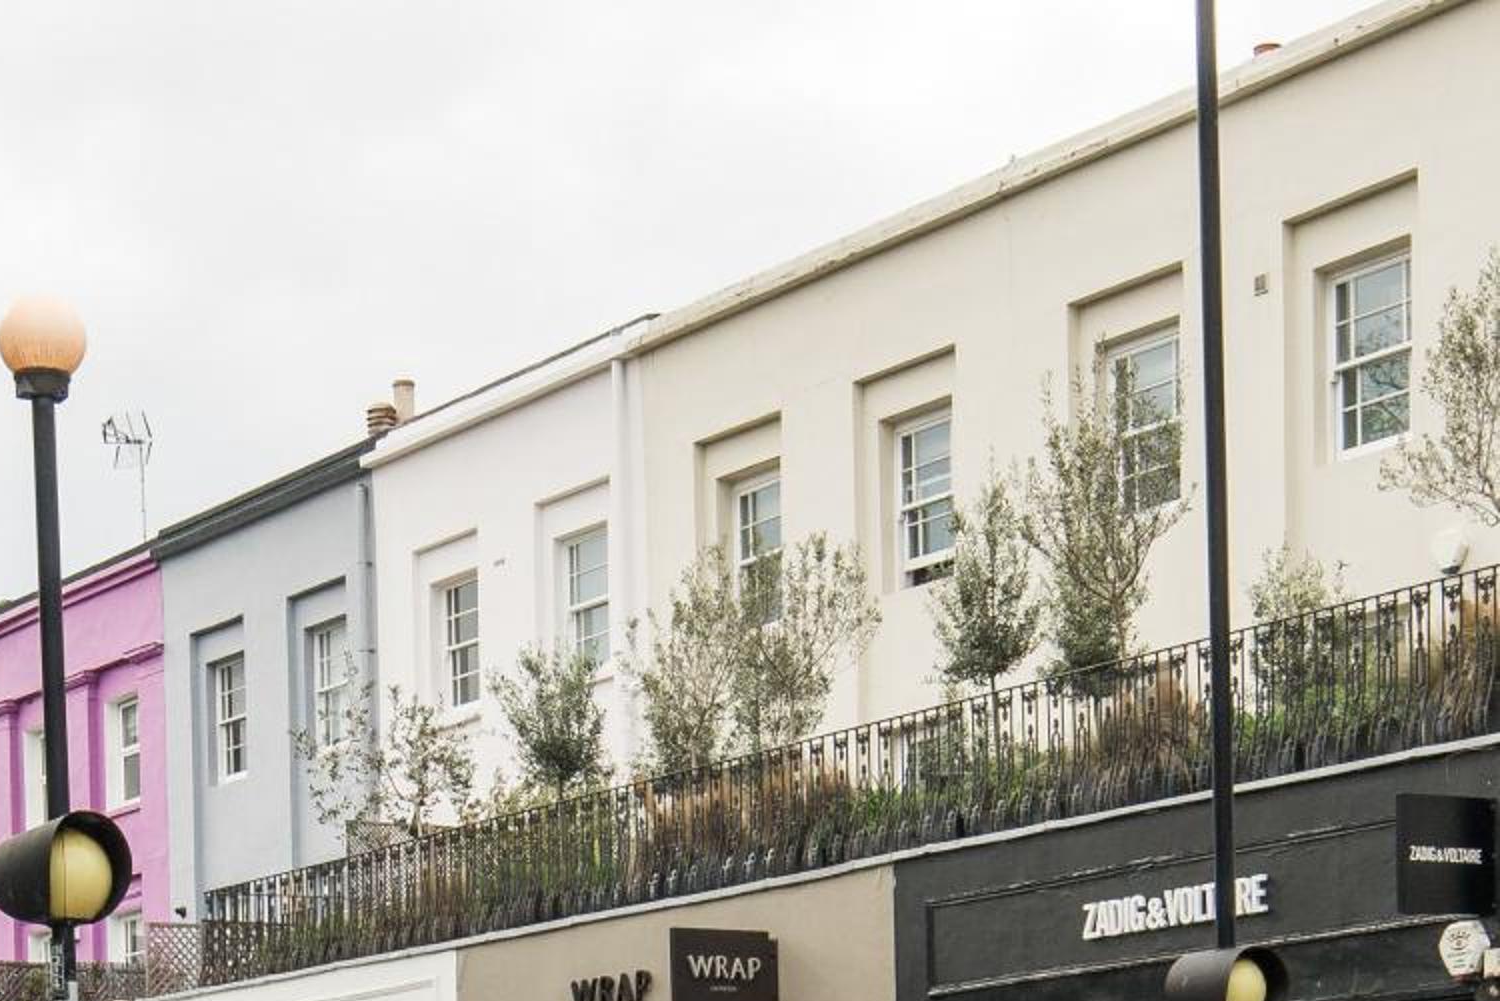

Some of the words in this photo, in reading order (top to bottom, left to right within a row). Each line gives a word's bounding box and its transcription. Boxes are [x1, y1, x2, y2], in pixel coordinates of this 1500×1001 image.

[1409, 845, 1482, 865] ZADIG&VOLTAIRE
[1082, 874, 1269, 941] ZADIG&VOLTRE
[687, 954, 761, 980] WRAP
